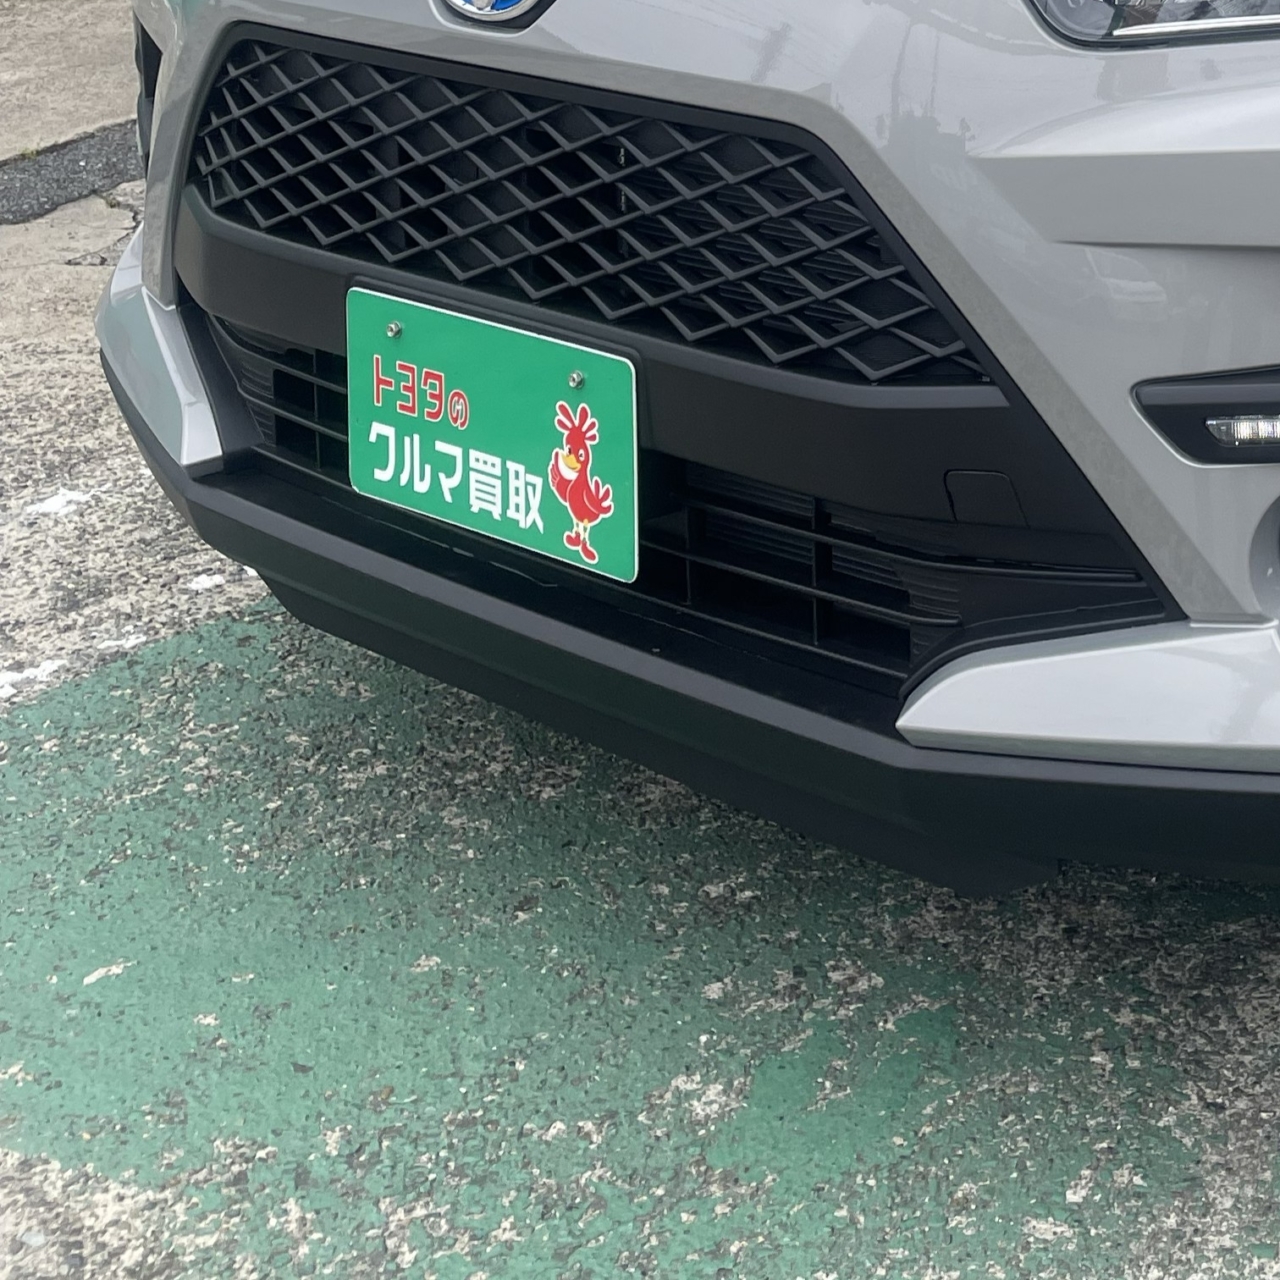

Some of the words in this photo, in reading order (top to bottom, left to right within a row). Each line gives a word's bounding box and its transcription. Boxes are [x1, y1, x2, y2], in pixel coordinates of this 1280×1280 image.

[373, 354, 470, 430] トヨタの
[368, 421, 544, 534] クルマ買取
